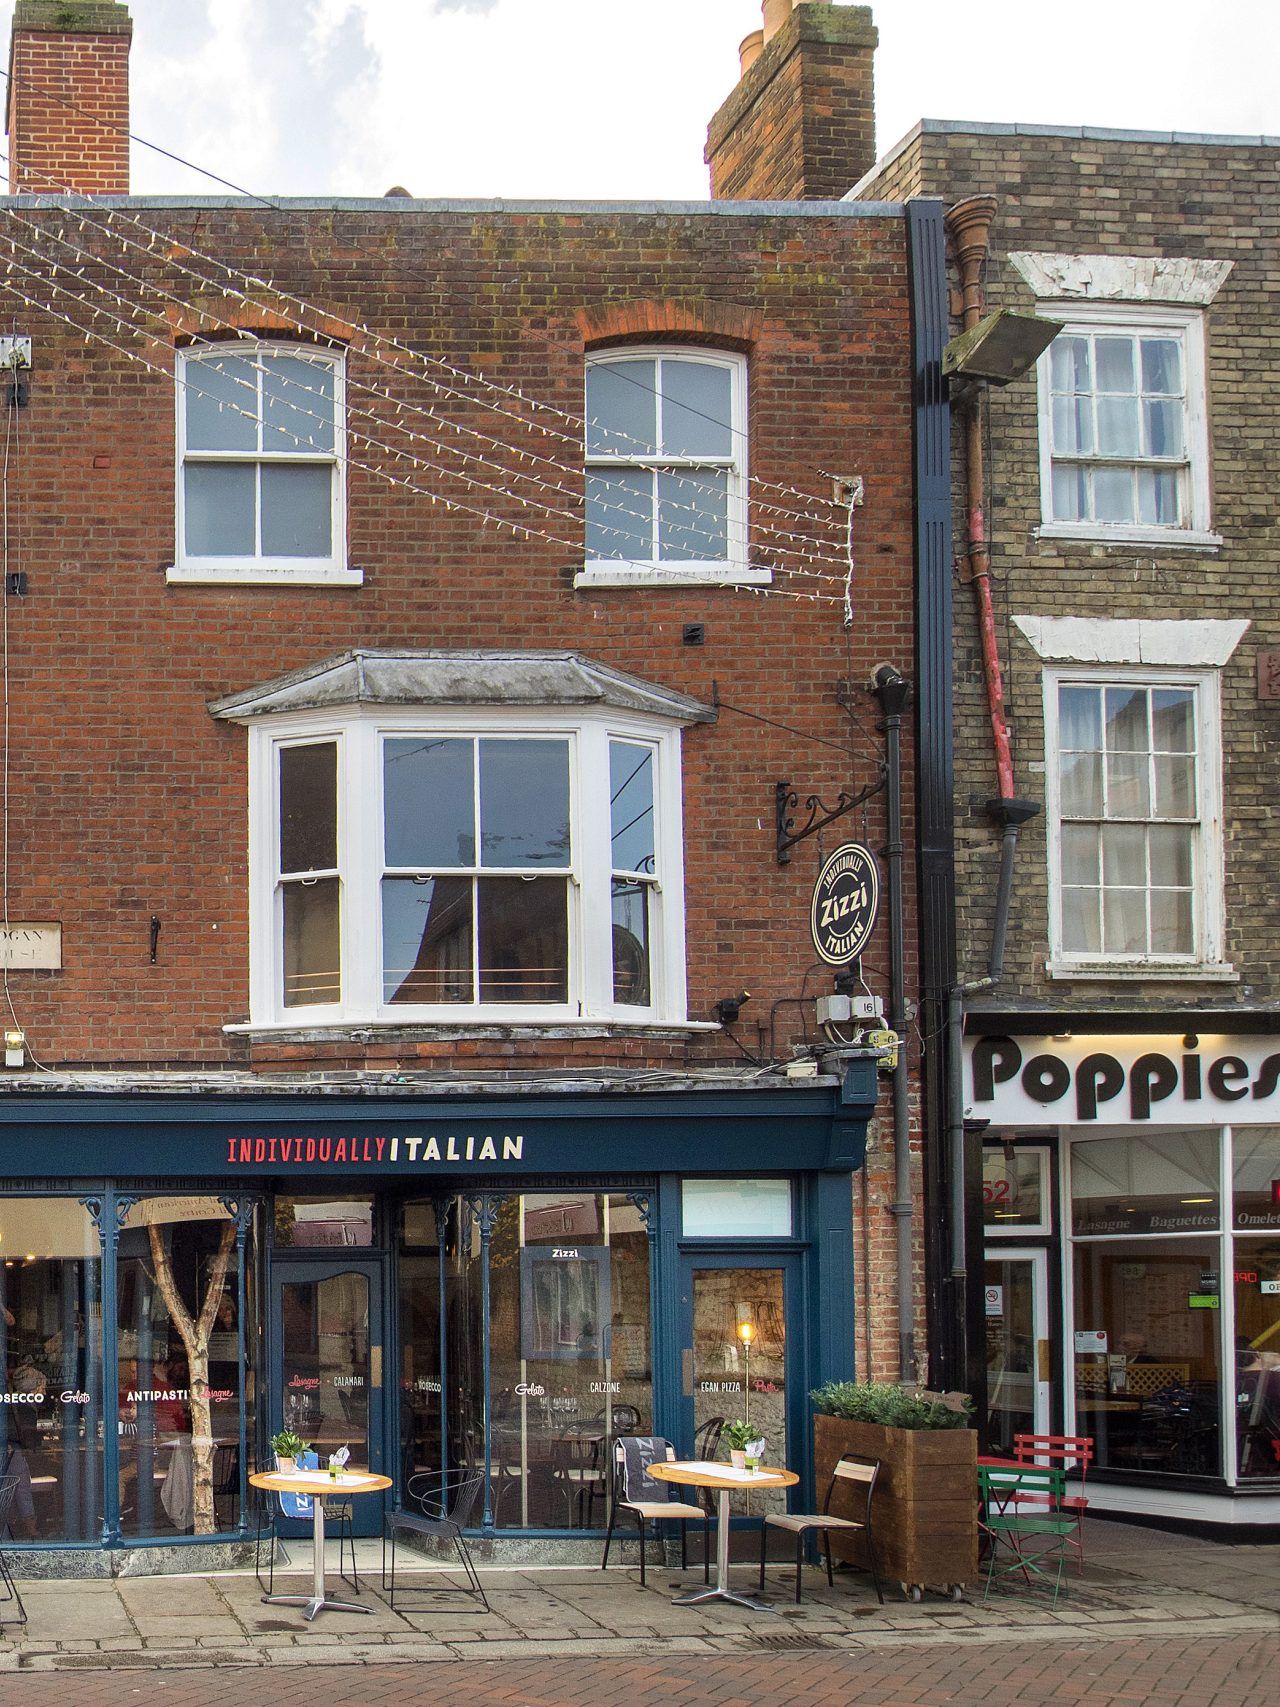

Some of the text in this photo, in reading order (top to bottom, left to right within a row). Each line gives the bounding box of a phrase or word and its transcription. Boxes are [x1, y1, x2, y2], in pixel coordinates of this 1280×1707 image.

[823, 854, 864, 889] INDIVIDUALLY
[821, 881, 867, 928] Zizzi
[825, 921, 864, 954] ITALIAN
[863, 1003, 873, 1012] 16
[1077, 1218, 1131, 1231] Lasagne
[1149, 1215, 1218, 1230] Baguettes
[552, 1249, 579, 1258] Zizzi
[333, 1376, 364, 1387] CALAMARI
[721, 1382, 741, 1392] PIZZA
[514, 1382, 621, 1396] Gelato CALZONE
[60, 1390, 90, 1404] Gelato
[126, 1390, 188, 1402] ANTIPASTI
